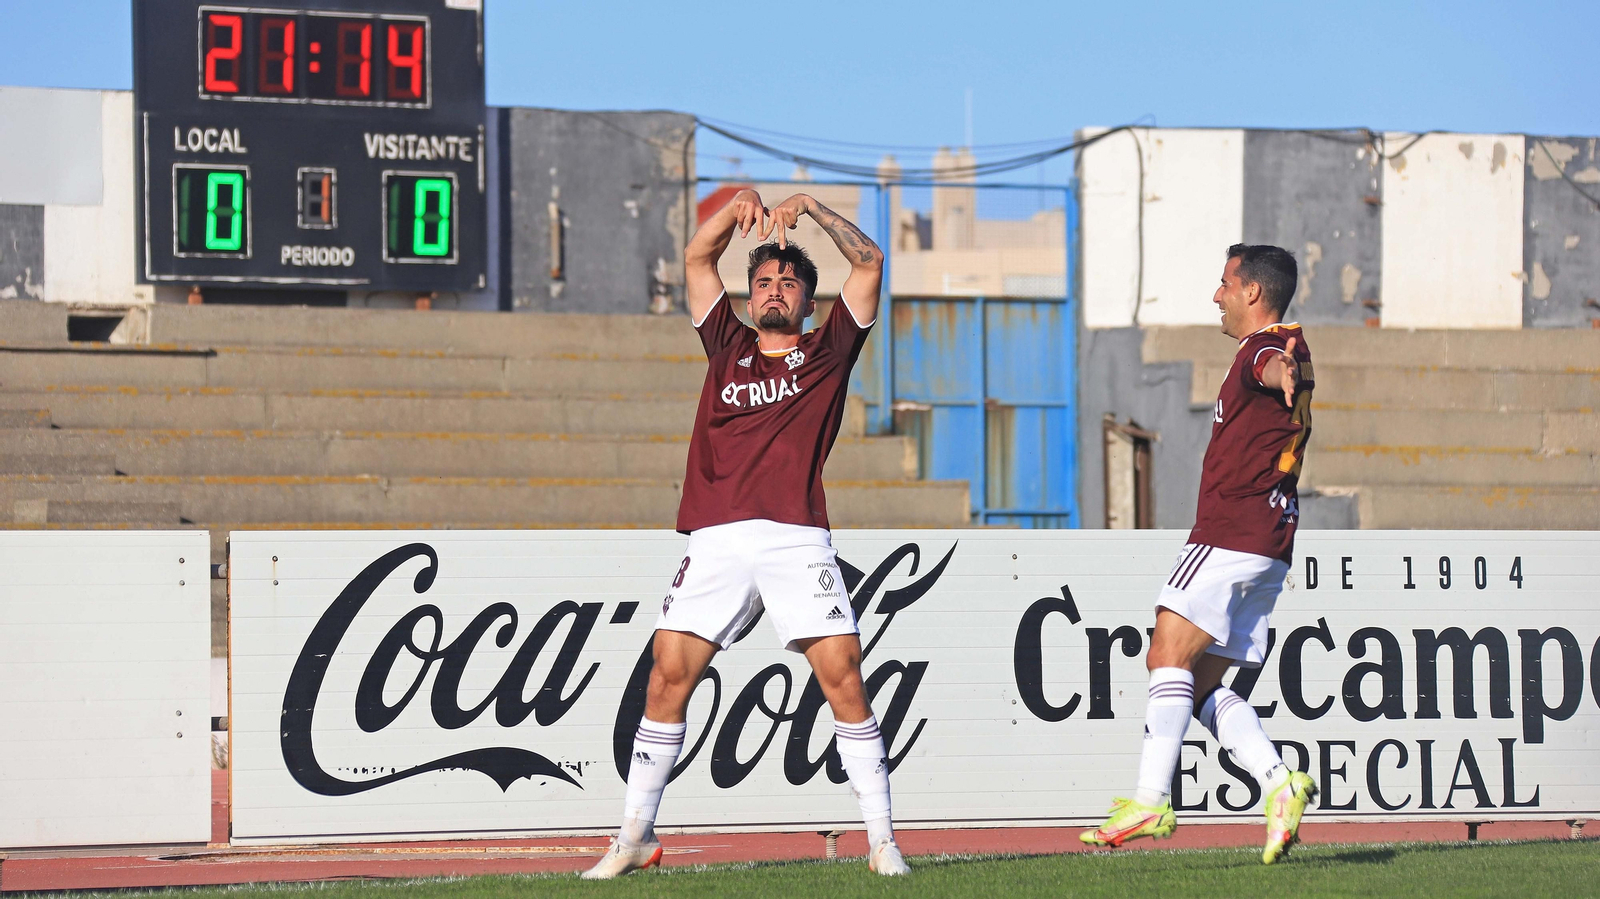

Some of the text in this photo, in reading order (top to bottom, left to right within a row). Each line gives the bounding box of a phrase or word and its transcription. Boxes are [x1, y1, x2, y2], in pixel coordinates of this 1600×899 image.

[205, 14, 424, 99] 21:14
[174, 126, 248, 154] LOCAL
[363, 132, 475, 163] VISITANTE
[205, 172, 244, 251] 0
[413, 179, 451, 257] 0
[280, 245, 355, 267] PERIODO
[1403, 556, 1524, 590] 1904
[1013, 584, 1600, 744] Crzcamp
